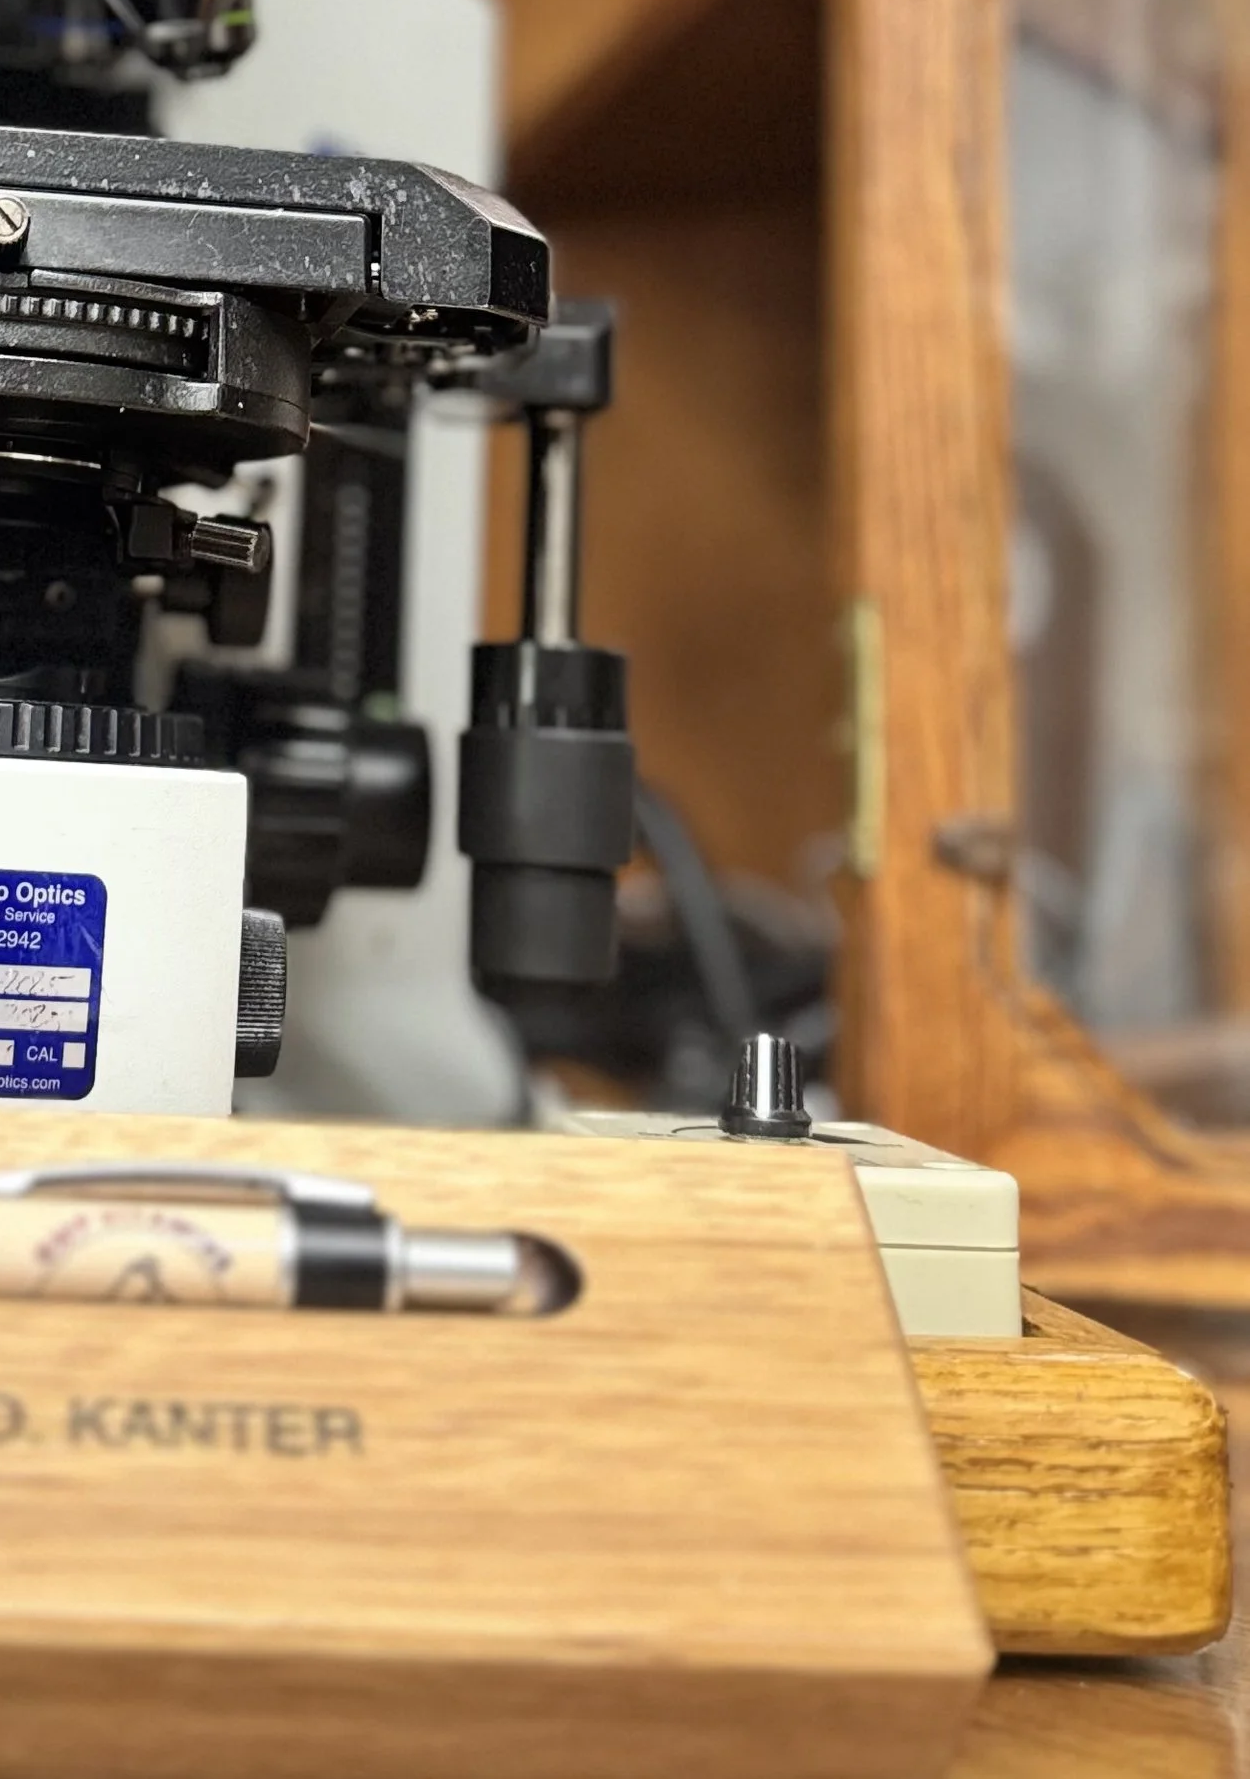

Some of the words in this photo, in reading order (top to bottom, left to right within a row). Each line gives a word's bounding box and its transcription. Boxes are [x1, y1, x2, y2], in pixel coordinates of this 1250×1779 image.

[15, 881, 86, 906] Optics
[4, 907, 56, 924] Service
[26, 1046, 59, 1062] CAL
[65, 1397, 366, 1459] KANTER
